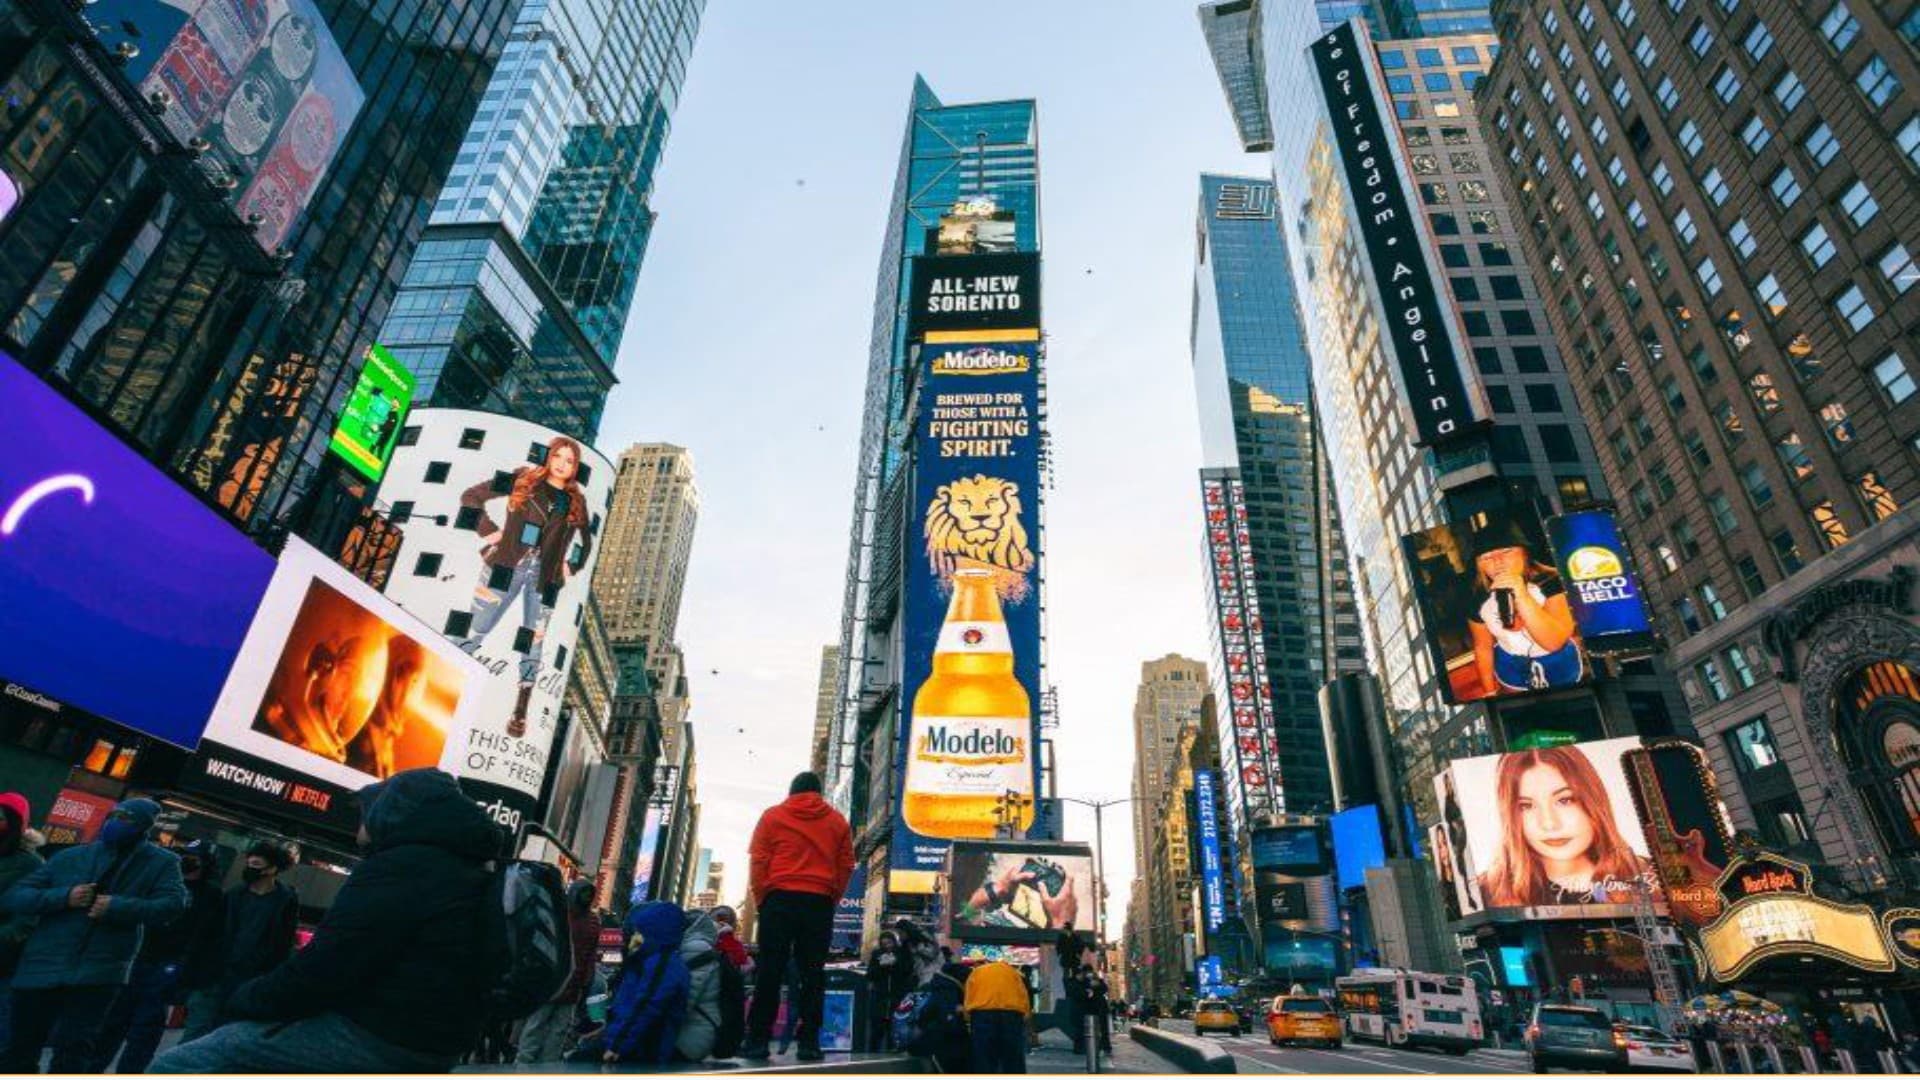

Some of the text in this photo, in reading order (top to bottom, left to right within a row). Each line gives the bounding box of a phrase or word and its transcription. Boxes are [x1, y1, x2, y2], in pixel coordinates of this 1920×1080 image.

[1347, 103, 1395, 225] Freedom
[1392, 261, 1455, 434] Angelina
[930, 275, 1020, 294] ALL-NEW
[927, 293, 1021, 313] SORENTO
[944, 351, 1018, 370] Modelo
[936, 392, 1024, 405] BREWED FOR
[932, 406, 1029, 419] THOSE WITH A
[929, 419, 1029, 438] FIGHTING
[940, 439, 1016, 457] SPIRIT.
[1573, 575, 1628, 592] TACO
[1581, 587, 1635, 604] BELL
[469, 728, 511, 754] THIS
[927, 725, 1015, 754] Modelo
[467, 752, 497, 771] OF
[206, 758, 332, 812] WATCH NOW NETFLIX
[476, 799, 521, 835] daq
[1672, 888, 1702, 903] Hard
